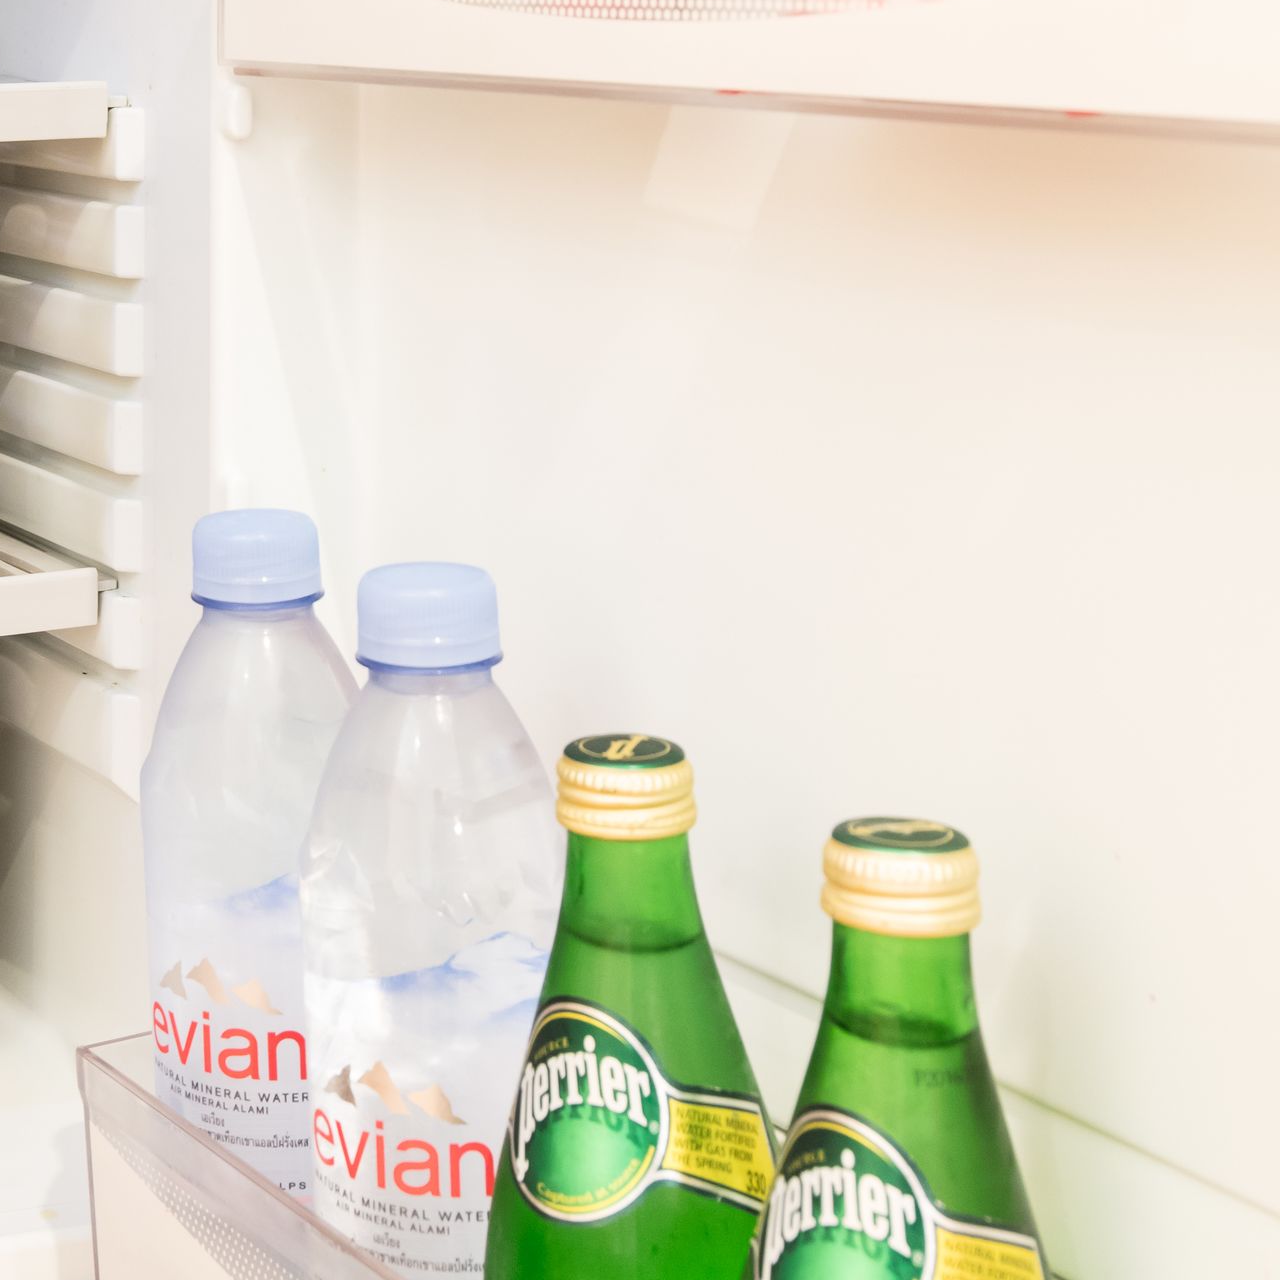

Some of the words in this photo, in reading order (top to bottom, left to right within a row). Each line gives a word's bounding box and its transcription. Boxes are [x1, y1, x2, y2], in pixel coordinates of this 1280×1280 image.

[152, 1001, 309, 1081] evian
[184, 1090, 229, 1111] MINERAL
[232, 1104, 270, 1115] ALAMI
[191, 1079, 251, 1102] MINERAL
[258, 1091, 310, 1103] WATER
[313, 1107, 495, 1199] evian
[745, 1169, 767, 1195] 330
[353, 1207, 405, 1231] MINERAL
[409, 1222, 452, 1236] ALAMI
[361, 1196, 431, 1220] MINERAL
[438, 1210, 492, 1222] WATE
